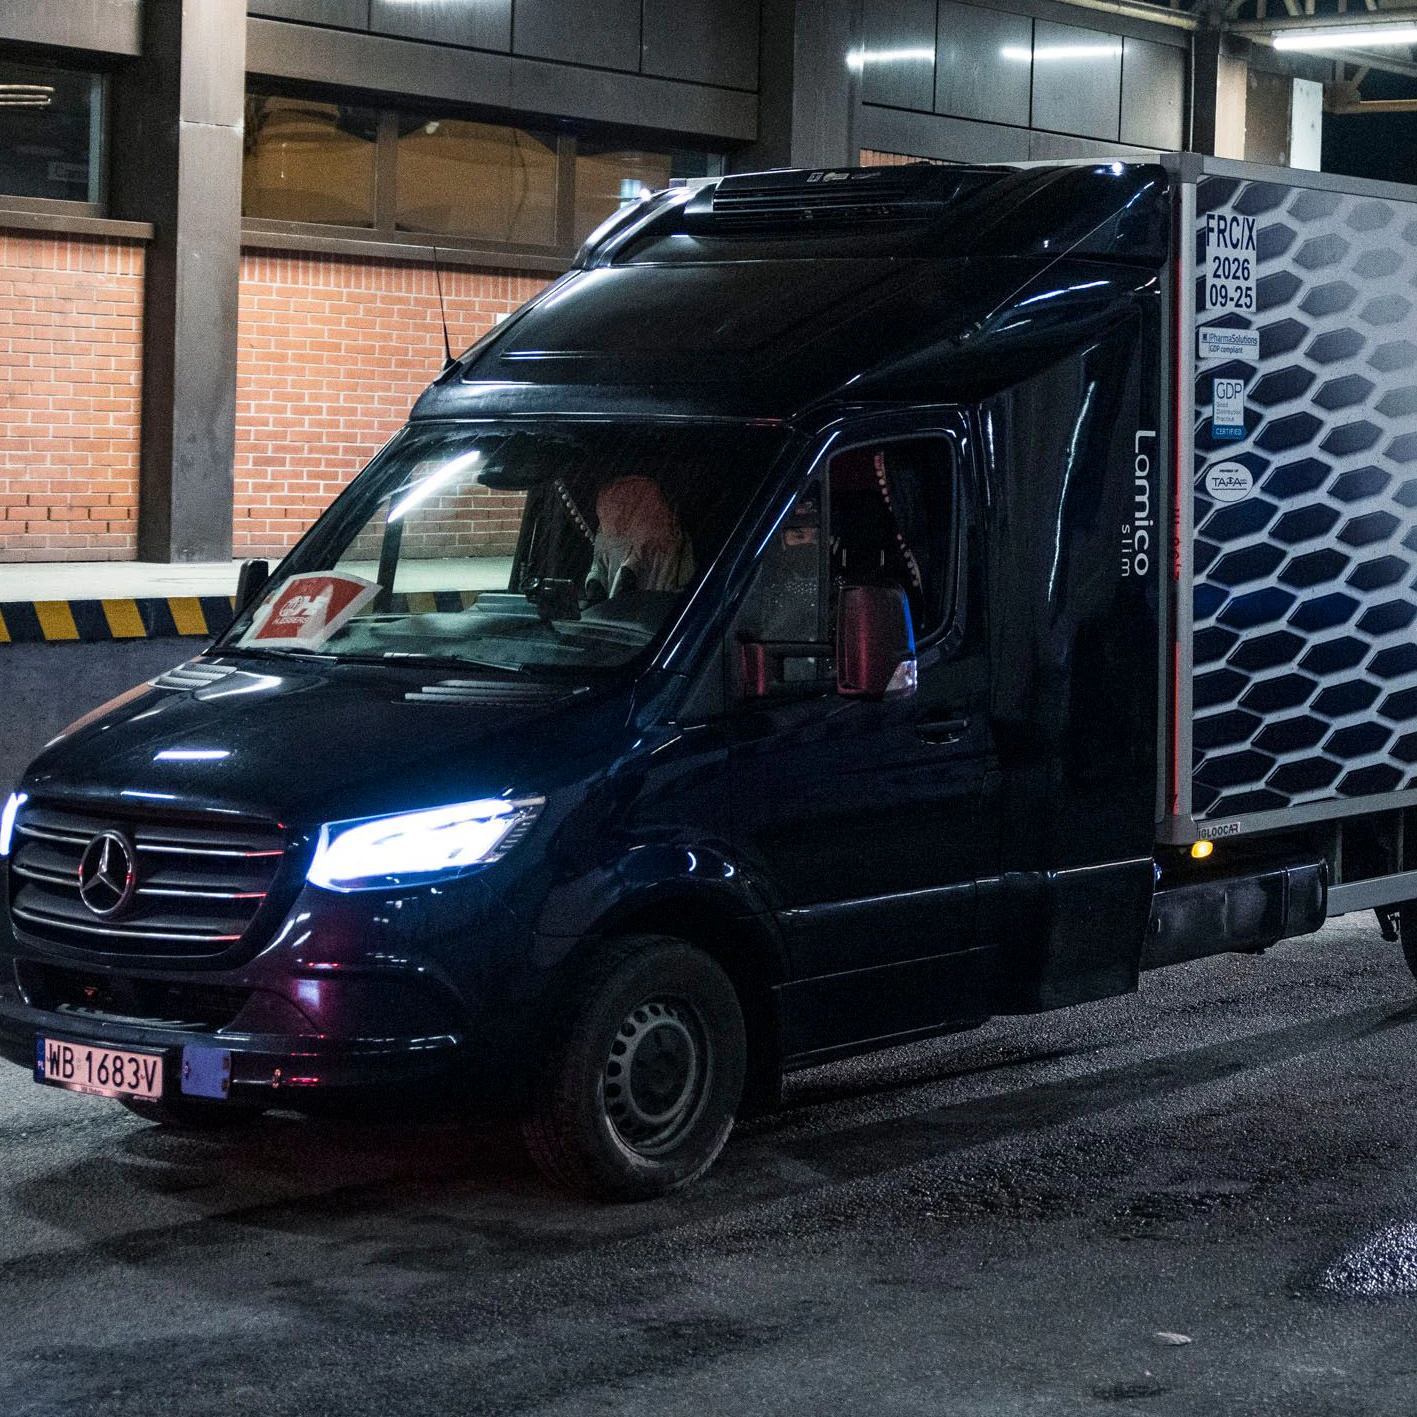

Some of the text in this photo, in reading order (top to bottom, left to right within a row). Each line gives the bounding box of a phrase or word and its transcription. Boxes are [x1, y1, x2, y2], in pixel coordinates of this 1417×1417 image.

[1206, 213, 1255, 251] FRC/X
[1212, 255, 1250, 281] 2026
[1209, 283, 1253, 309] 09-25
[1216, 381, 1243, 400] GDP
[1134, 430, 1156, 576] Lamico
[1121, 524, 1132, 577] slim
[48, 1043, 157, 1093] WB 1683V
